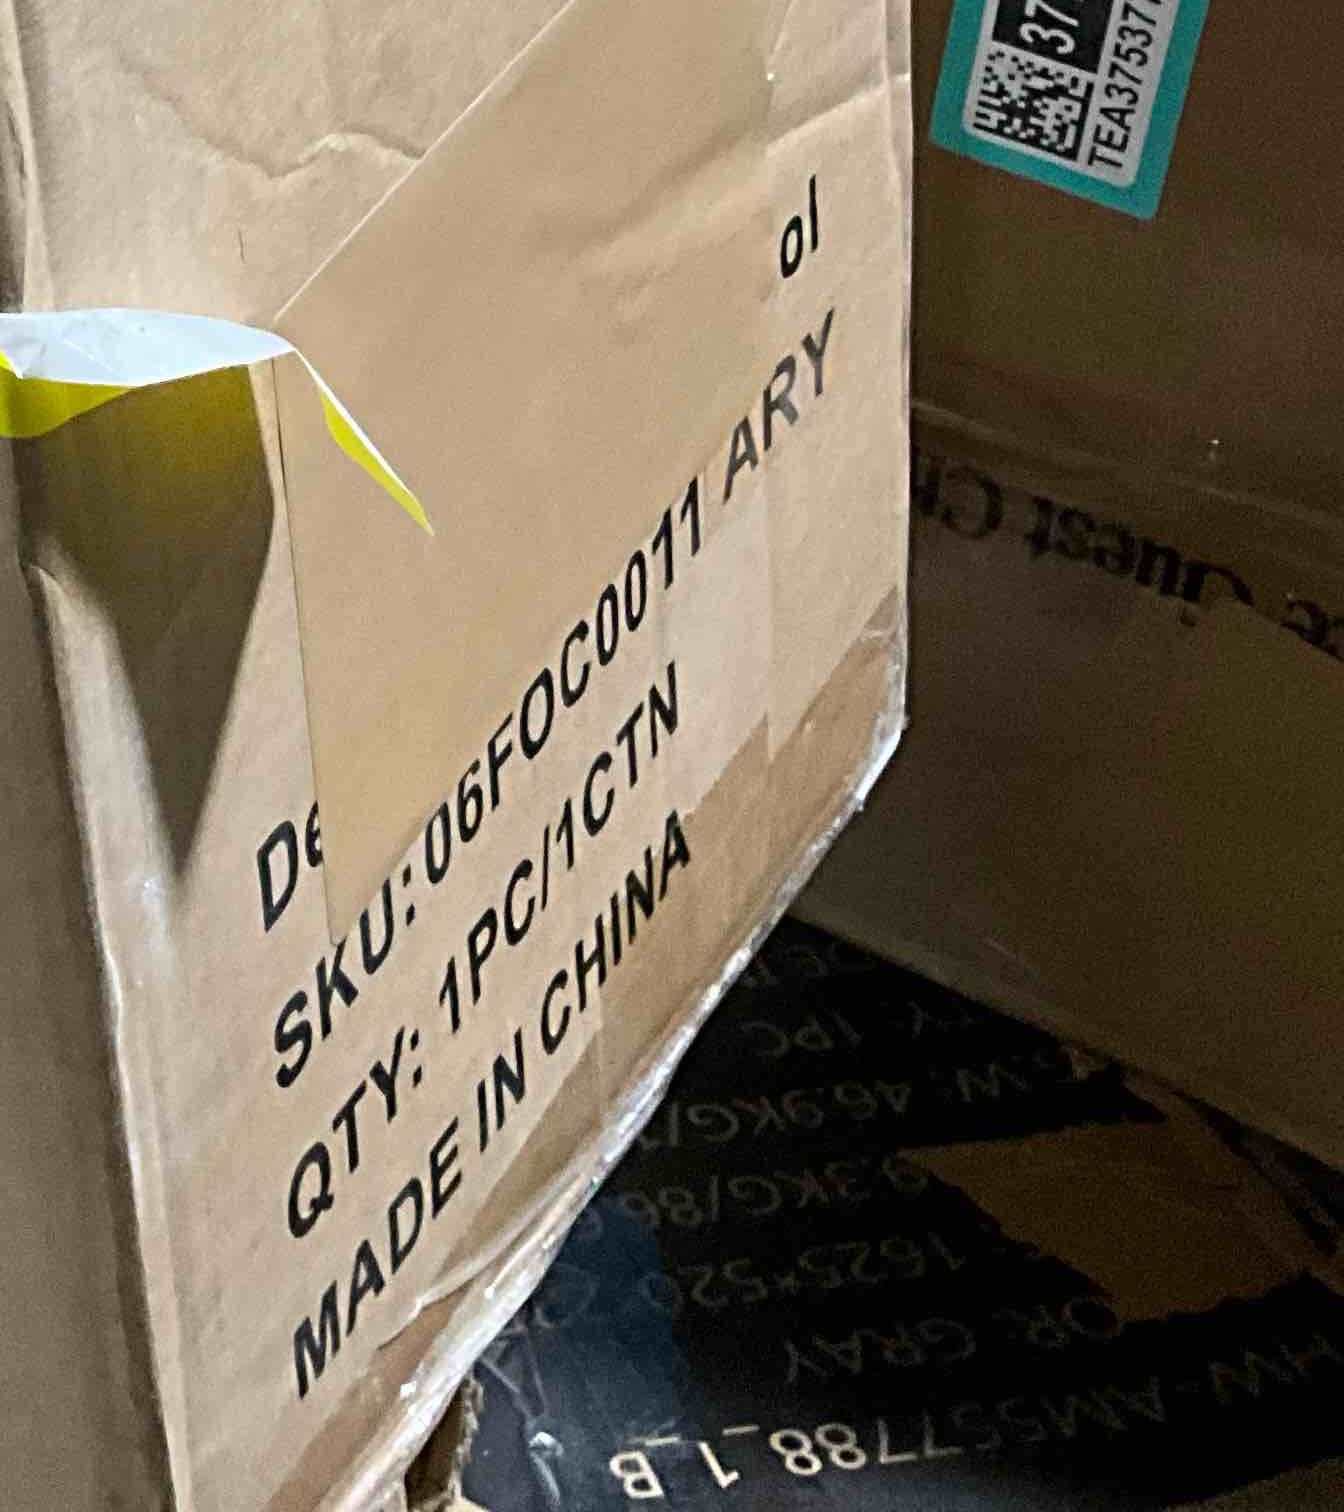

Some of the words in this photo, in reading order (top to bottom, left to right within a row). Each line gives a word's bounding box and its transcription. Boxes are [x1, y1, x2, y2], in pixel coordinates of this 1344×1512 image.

[723, 307, 837, 506] ARY
[294, 1117, 464, 1400] MADE
[479, 1027, 527, 1154] IN
[541, 809, 691, 1056] CHINA
